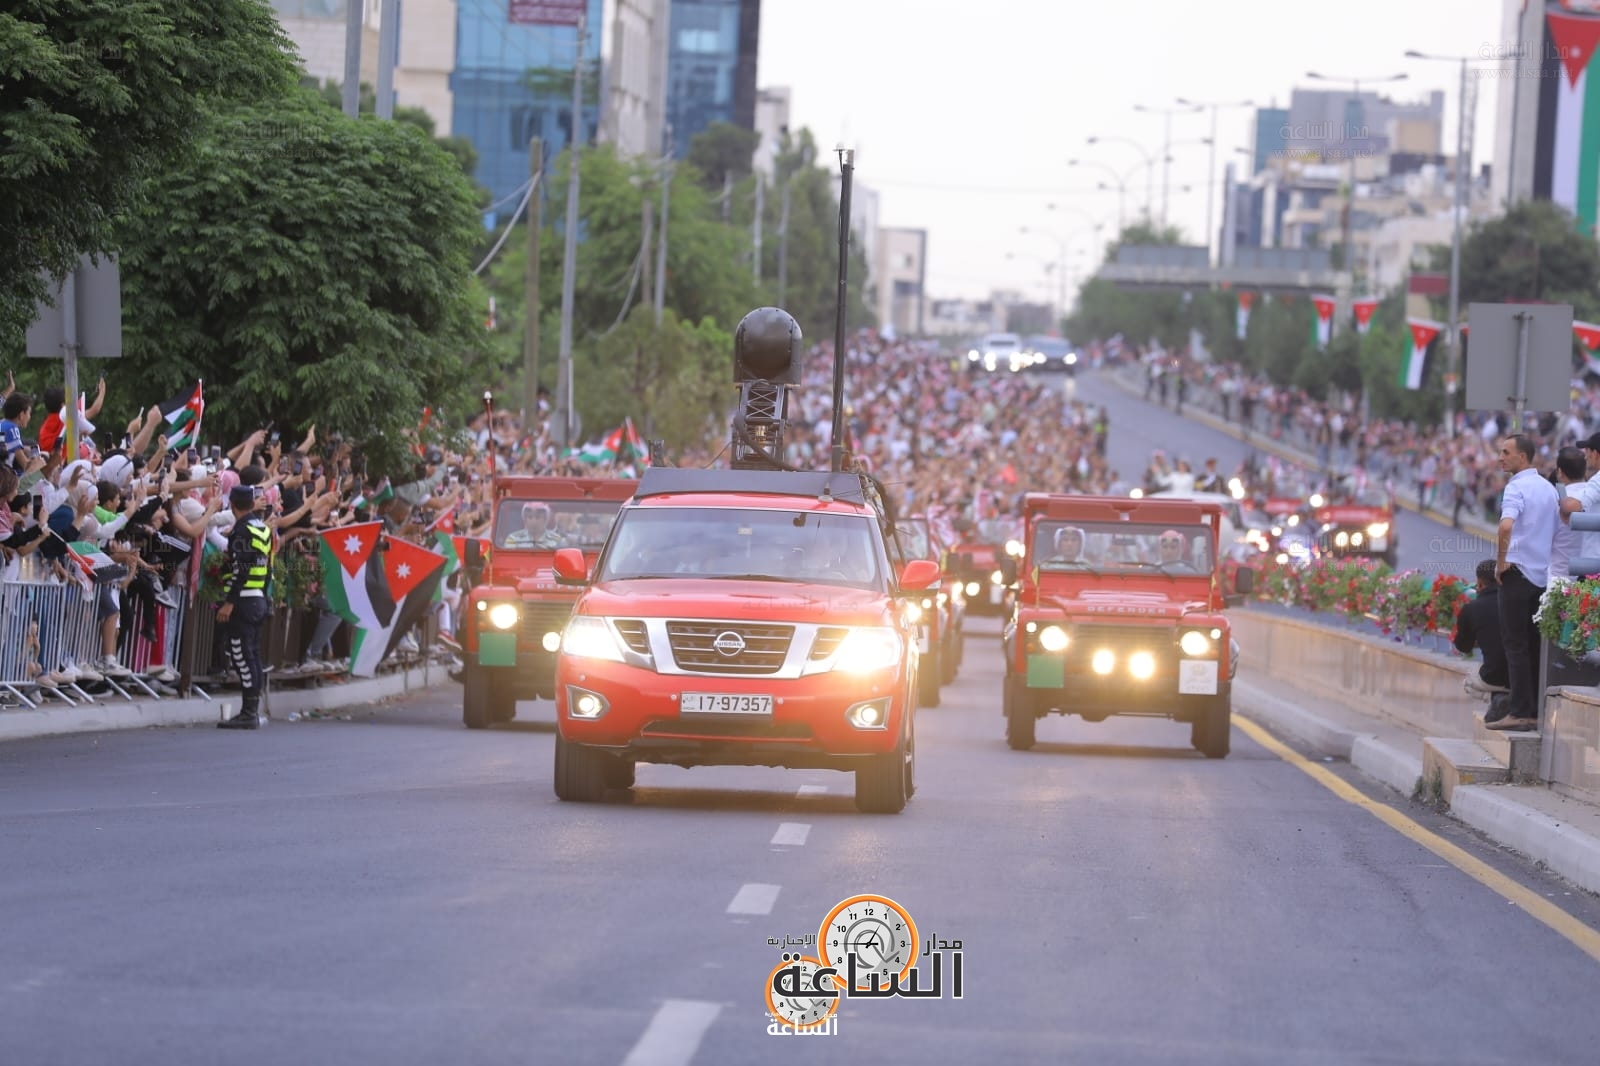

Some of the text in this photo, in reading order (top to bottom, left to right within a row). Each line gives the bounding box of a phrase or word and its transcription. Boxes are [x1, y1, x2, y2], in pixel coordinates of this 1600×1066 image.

[1087, 606, 1166, 615] DEFENDER
[716, 640, 742, 648] NISSAN
[699, 696, 770, 712] 17-97357
